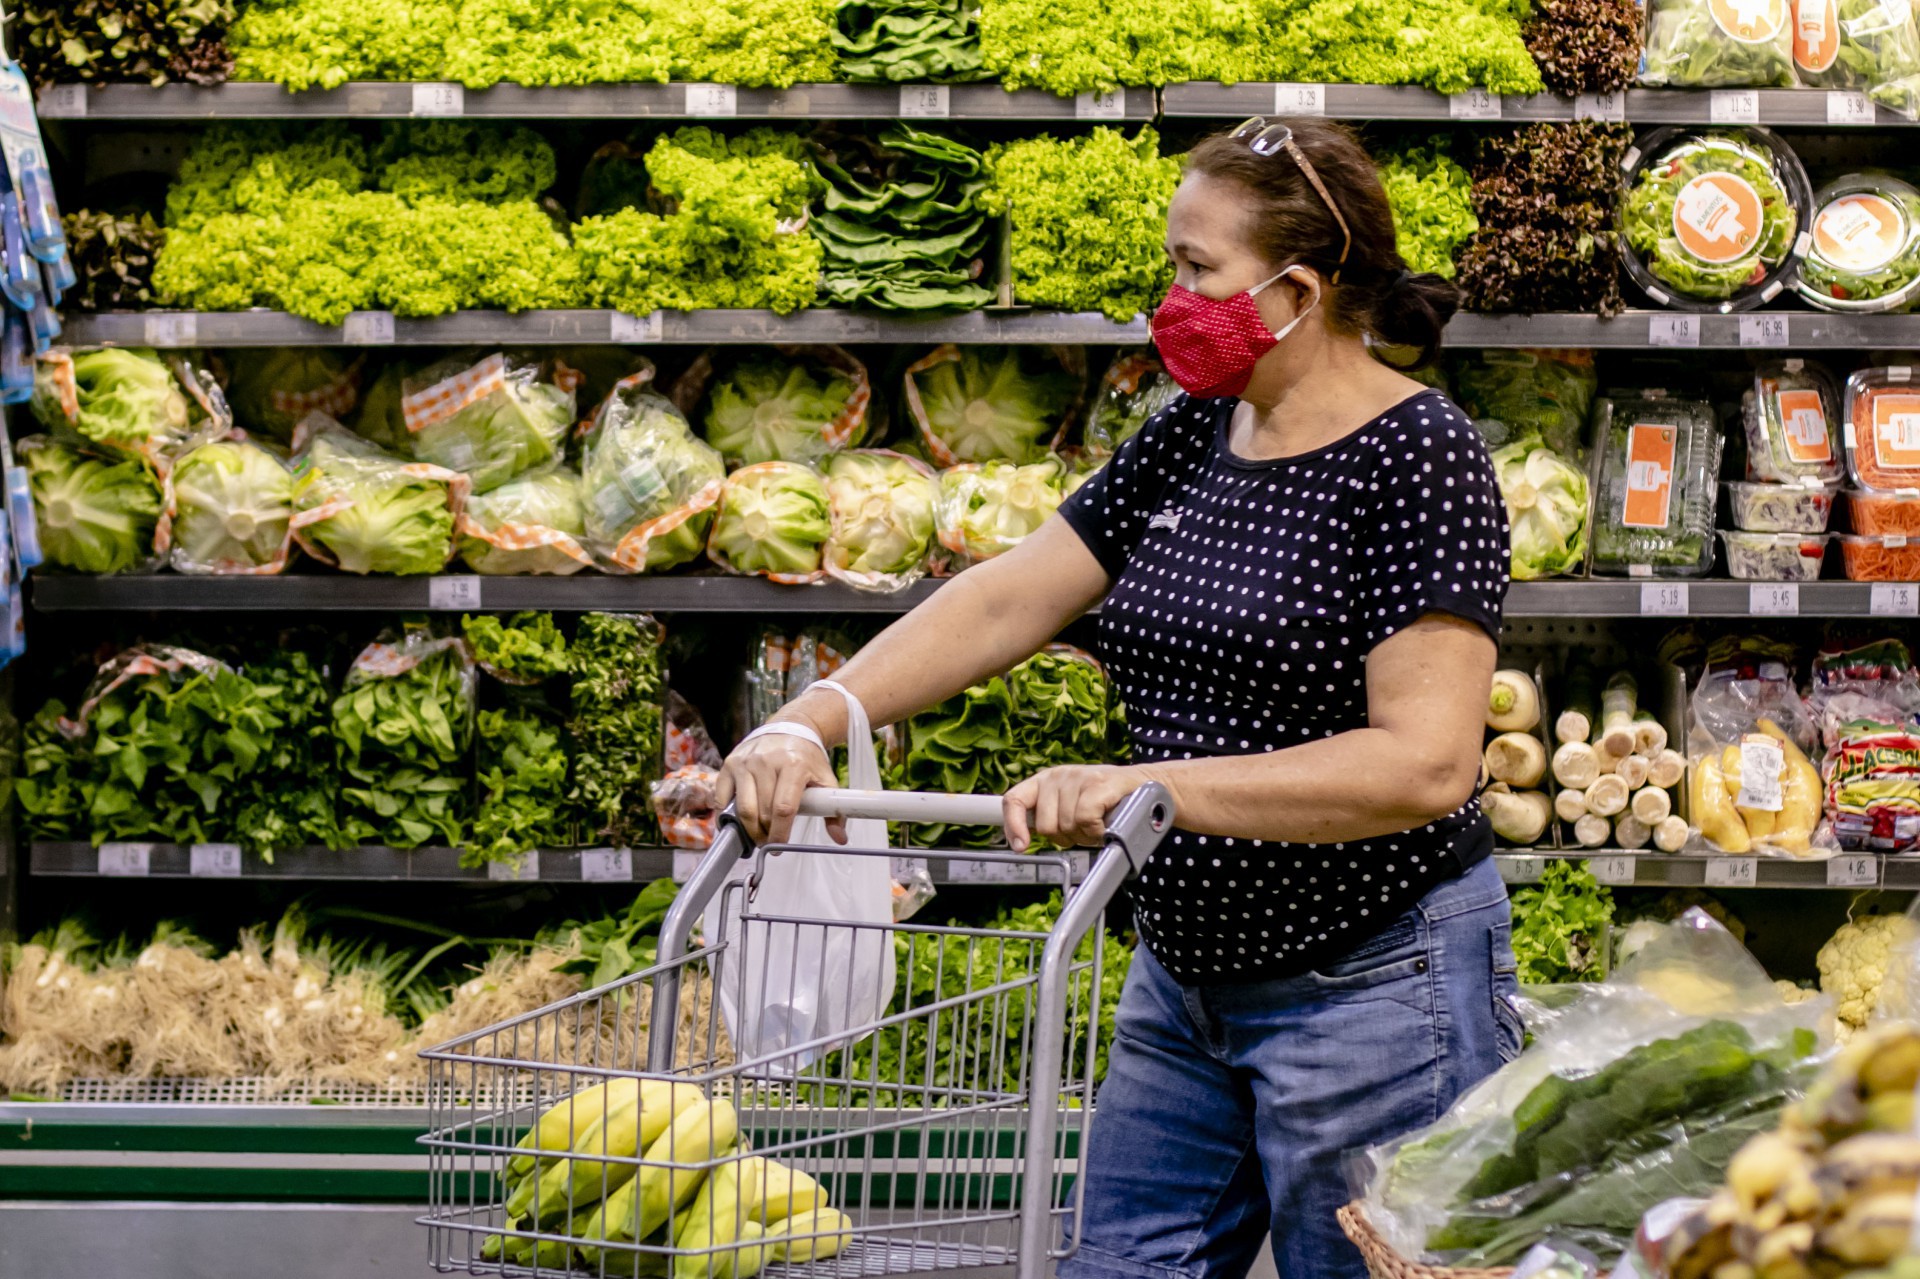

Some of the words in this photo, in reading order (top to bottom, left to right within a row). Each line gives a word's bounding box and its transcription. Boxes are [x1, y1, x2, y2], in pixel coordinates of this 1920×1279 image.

[1298, 90, 1316, 106] 3.29
[1472, 92, 1490, 108] 3.29
[1671, 320, 1689, 336] 4.19
[1761, 321, 1783, 337] 16.99
[1661, 589, 1679, 605] 5.19
[1772, 590, 1790, 606] 9.45
[1891, 589, 1908, 606] 7.35
[1515, 860, 1533, 875] 6.75
[1848, 860, 1866, 876] 4.05
